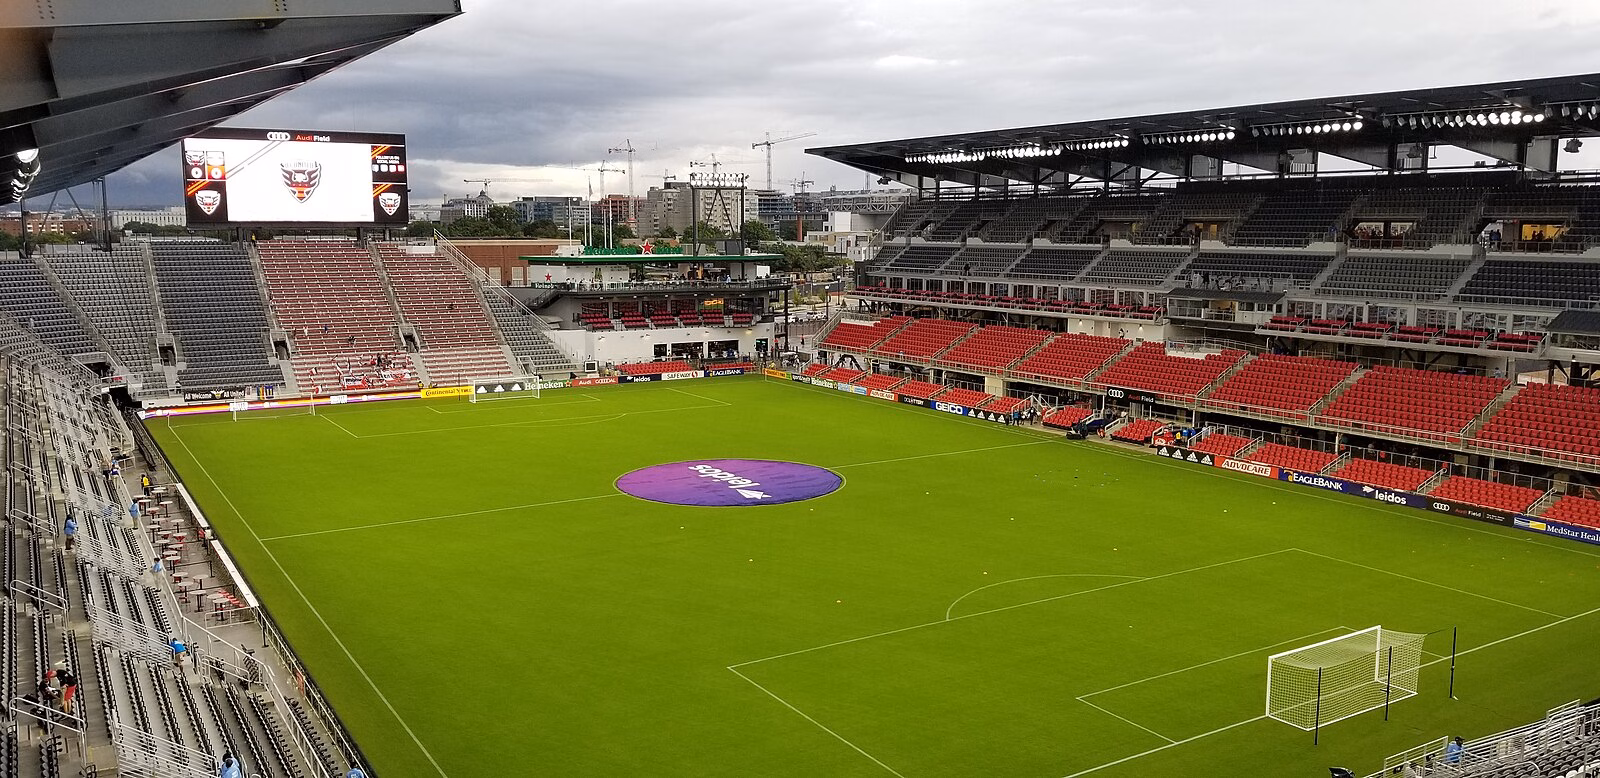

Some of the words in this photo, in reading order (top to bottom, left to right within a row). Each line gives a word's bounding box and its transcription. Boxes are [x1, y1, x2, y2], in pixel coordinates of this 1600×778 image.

[525, 381, 564, 390] Heneken
[191, 392, 212, 400] Welcome
[230, 390, 245, 398] United
[426, 388, 456, 396] Continental
[1141, 395, 1154, 403] Field
[935, 401, 963, 414] GEICO
[1222, 459, 1270, 476] ADVOCARE
[688, 464, 761, 489] leidos
[1375, 489, 1407, 505] leidos
[1467, 510, 1482, 518] Field
[1546, 525, 1579, 538] MedStar
